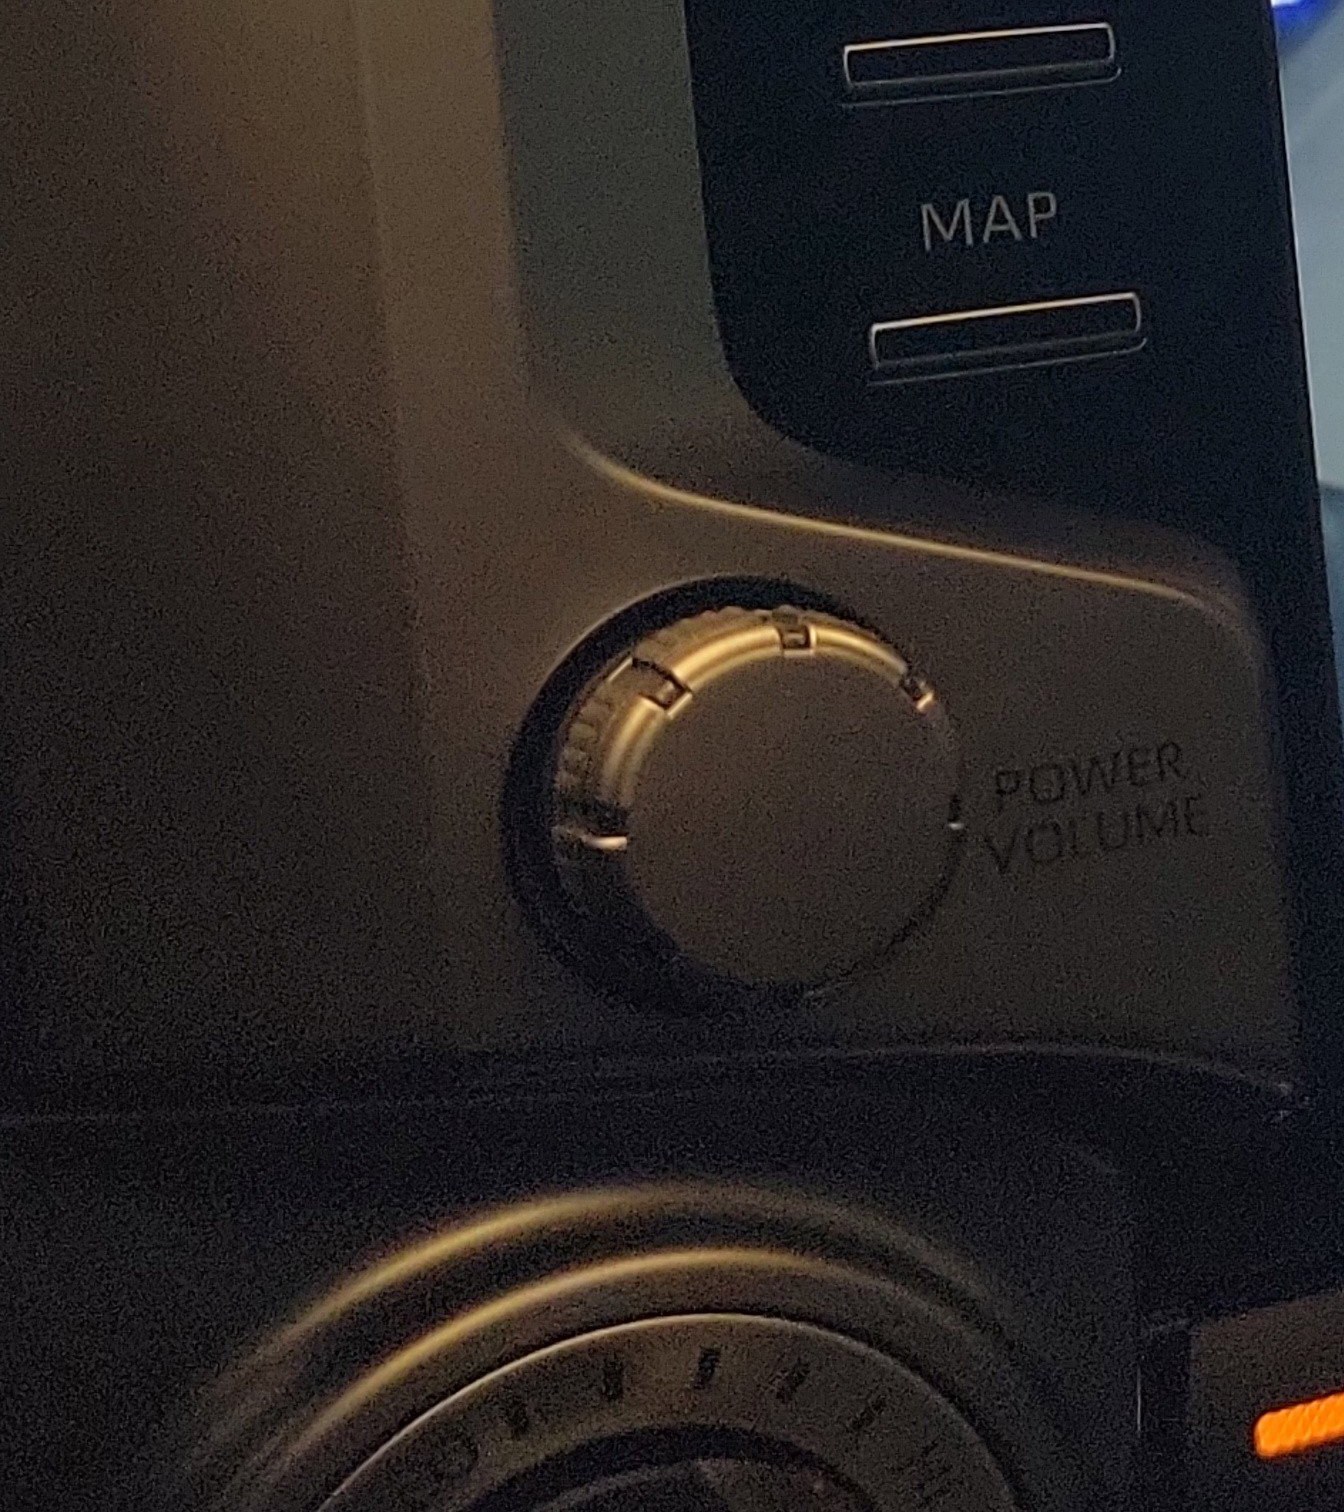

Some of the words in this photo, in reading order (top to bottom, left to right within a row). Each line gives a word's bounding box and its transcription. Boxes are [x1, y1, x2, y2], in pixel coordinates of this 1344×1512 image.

[920, 190, 1058, 253] MAP
[993, 739, 1187, 814] POWER
[984, 792, 1210, 875] VOLUME
